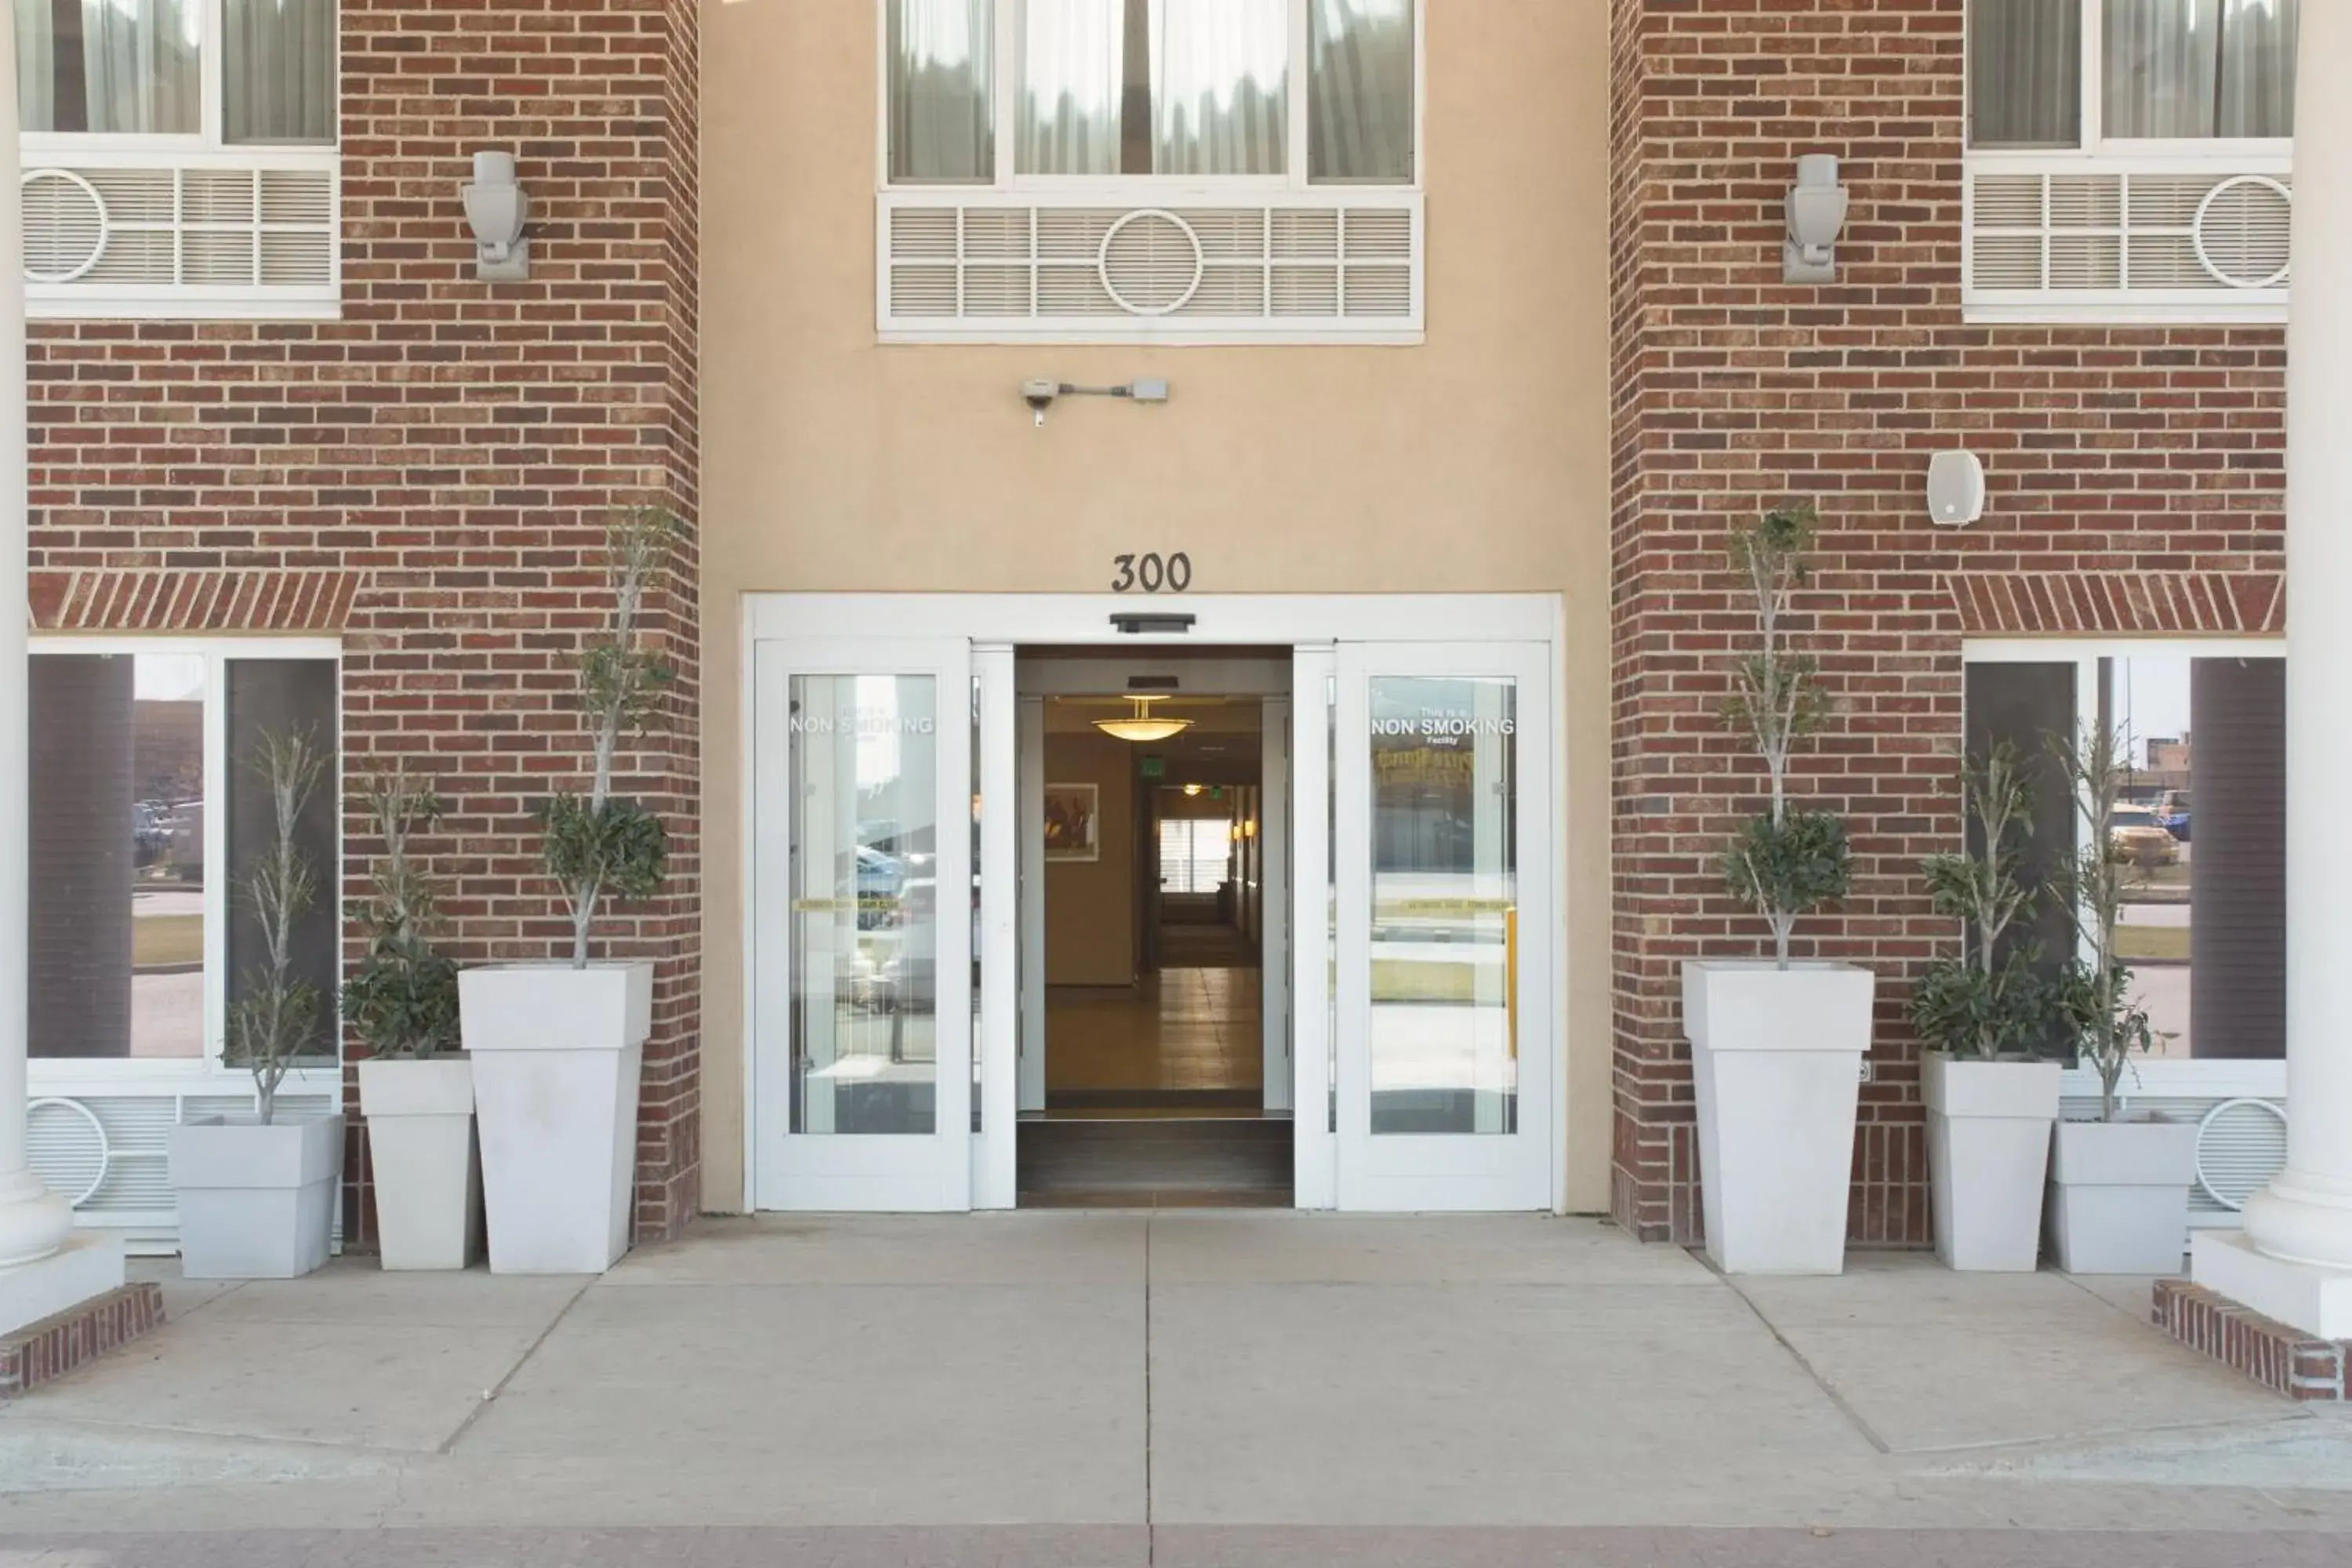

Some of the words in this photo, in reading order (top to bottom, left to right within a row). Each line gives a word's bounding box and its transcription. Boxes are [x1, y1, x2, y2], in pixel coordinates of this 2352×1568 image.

[1111, 551, 1191, 592] 300
[789, 717, 833, 734] NON
[1371, 719, 1414, 735] NON
[1421, 719, 1514, 735] SMOKING
